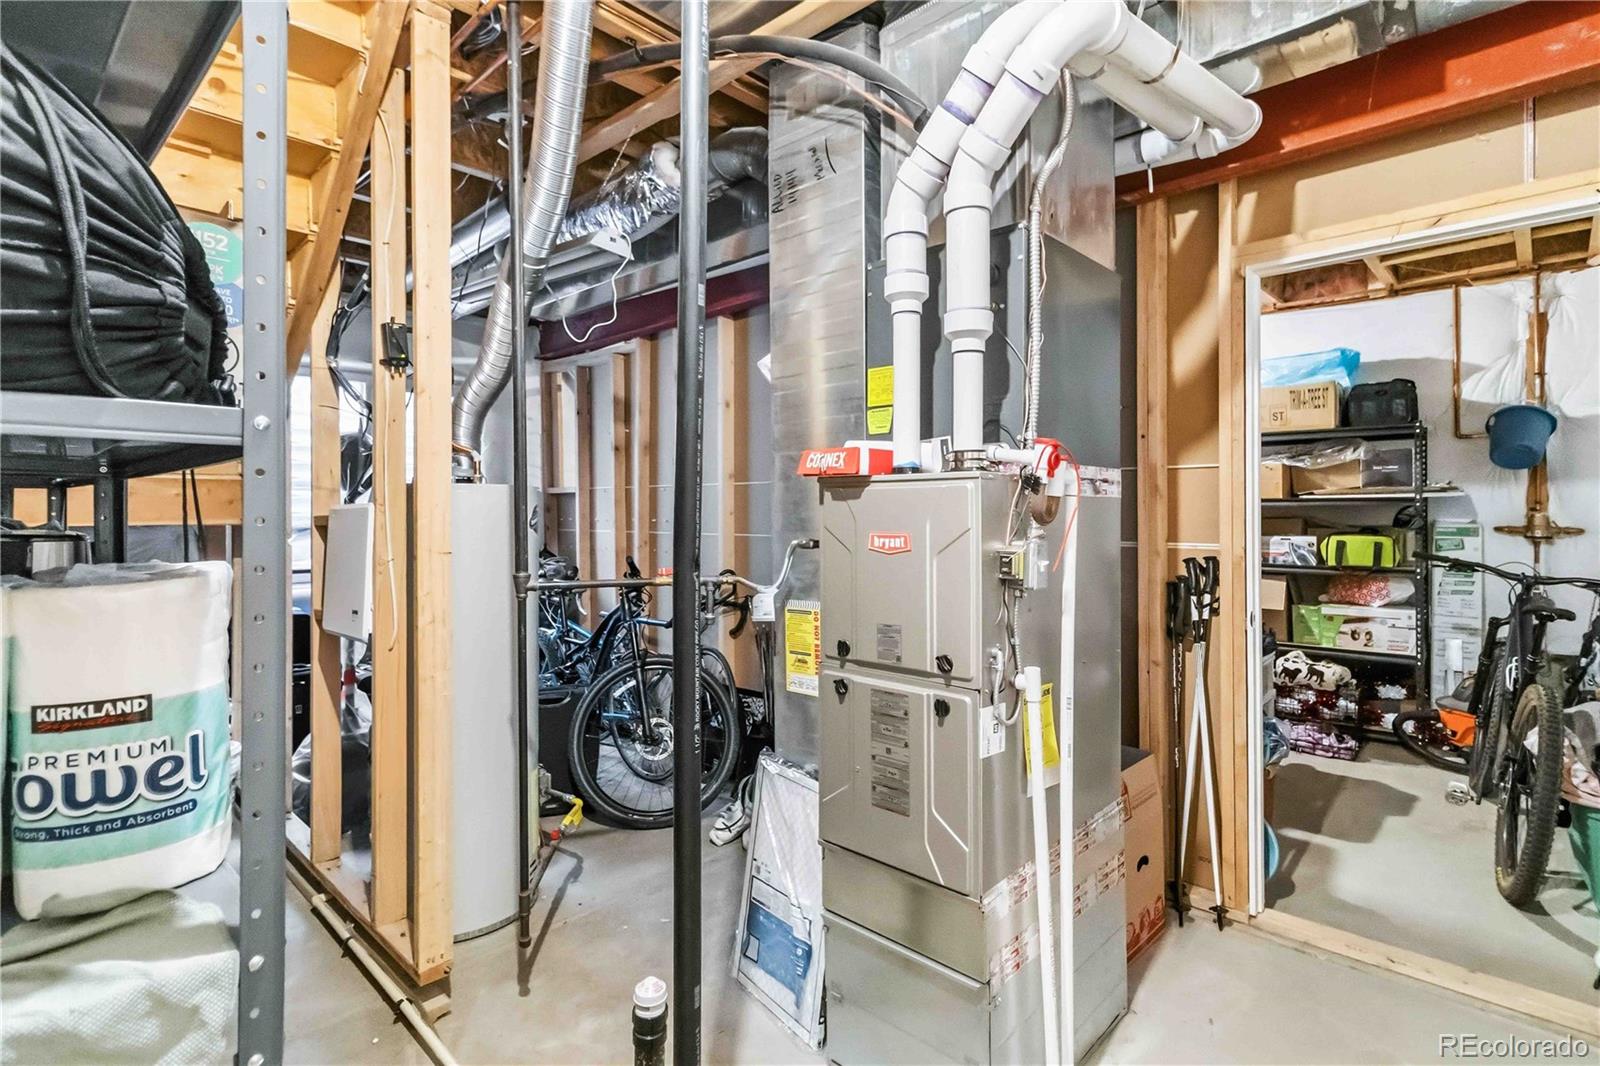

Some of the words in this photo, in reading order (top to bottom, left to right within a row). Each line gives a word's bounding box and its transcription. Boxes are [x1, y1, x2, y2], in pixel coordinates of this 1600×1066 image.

[1272, 411, 1284, 421] ST
[873, 535, 905, 549] bryant
[813, 610, 820, 622] DO
[36, 699, 148, 722] KIRKLAND
[28, 738, 173, 770] PREMIUM
[15, 733, 206, 816] owel
[54, 826, 90, 838] Thick
[95, 819, 122, 832] and
[127, 801, 194, 825] Absorbent
